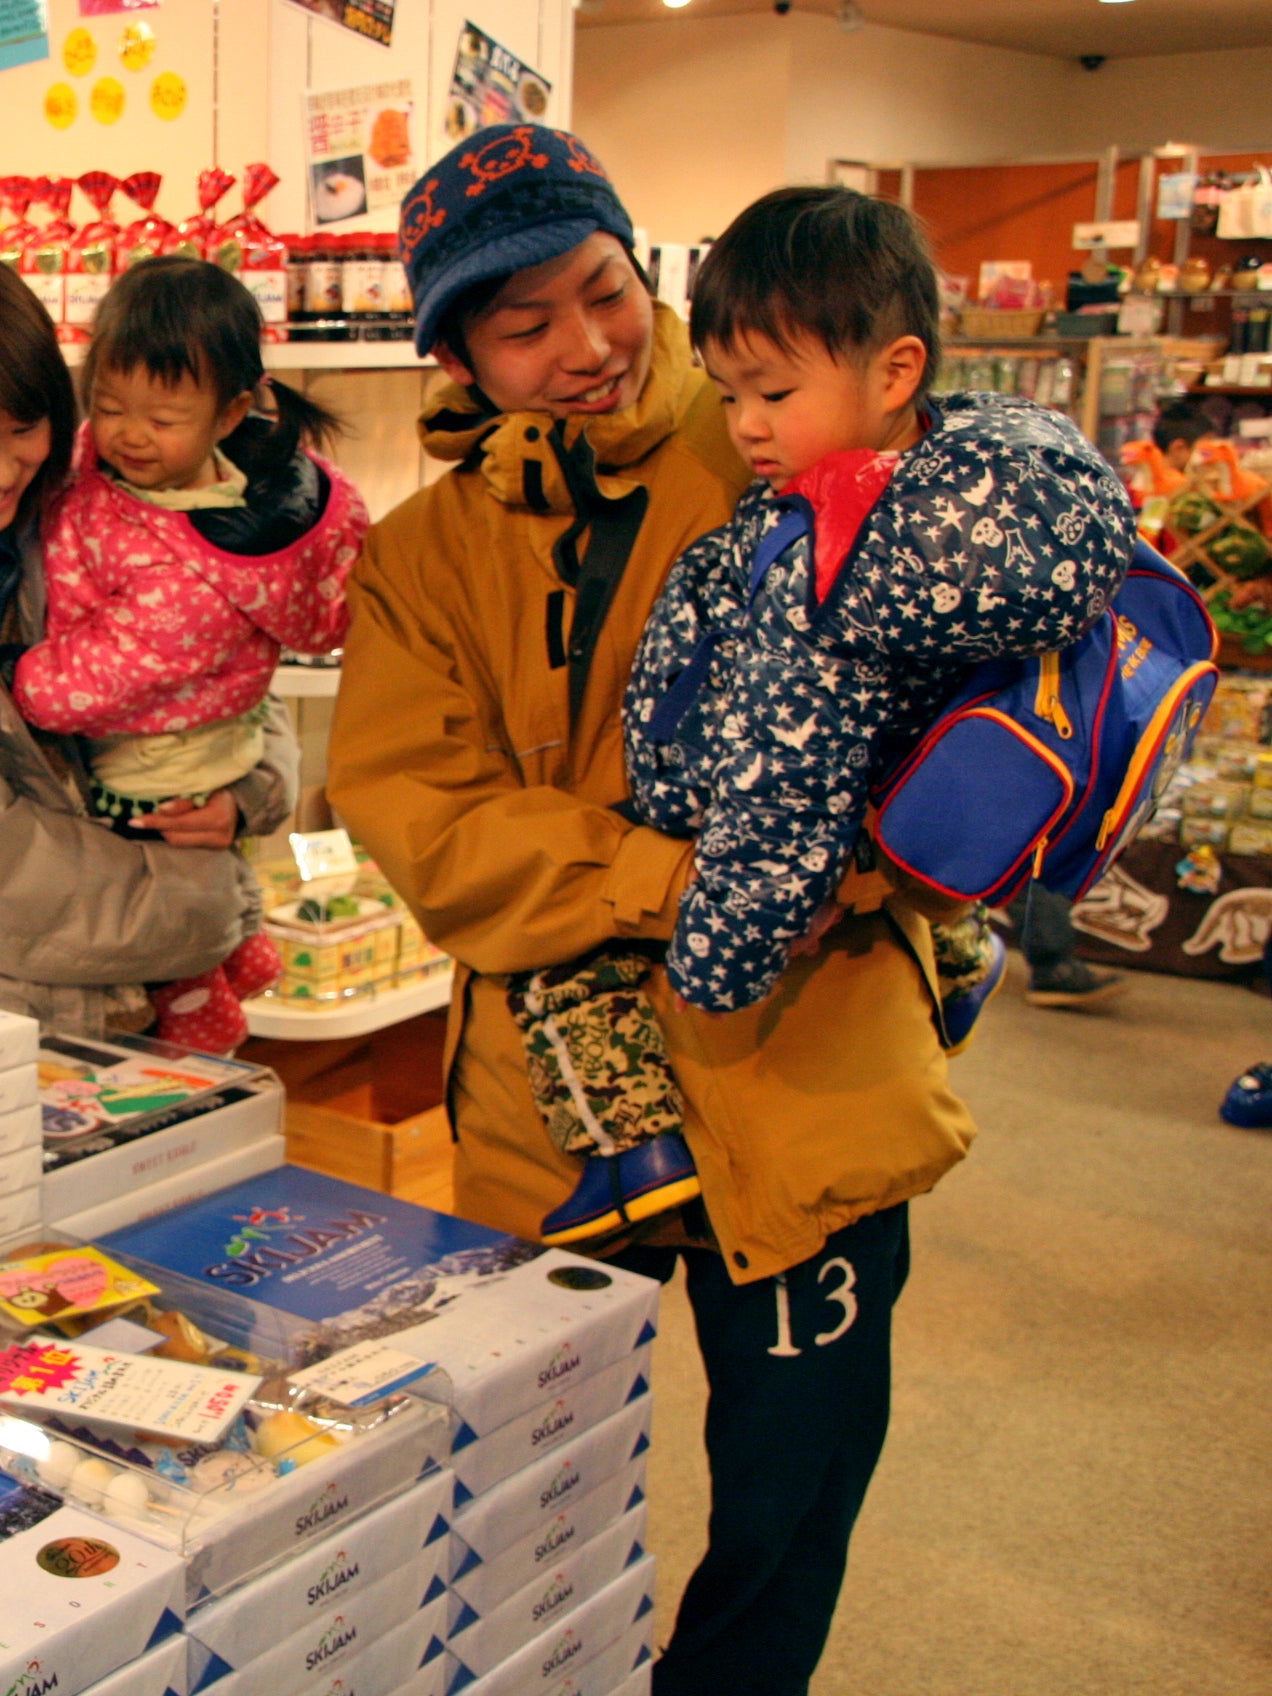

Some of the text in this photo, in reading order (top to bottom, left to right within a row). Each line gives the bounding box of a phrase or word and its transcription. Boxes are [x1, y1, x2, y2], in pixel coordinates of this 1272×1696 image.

[203, 1208, 388, 1286] SKIJAM
[767, 1256, 859, 1357] 13
[307, 1562, 360, 1605] SKIJAM
[305, 1625, 358, 1671] SKIJAM
